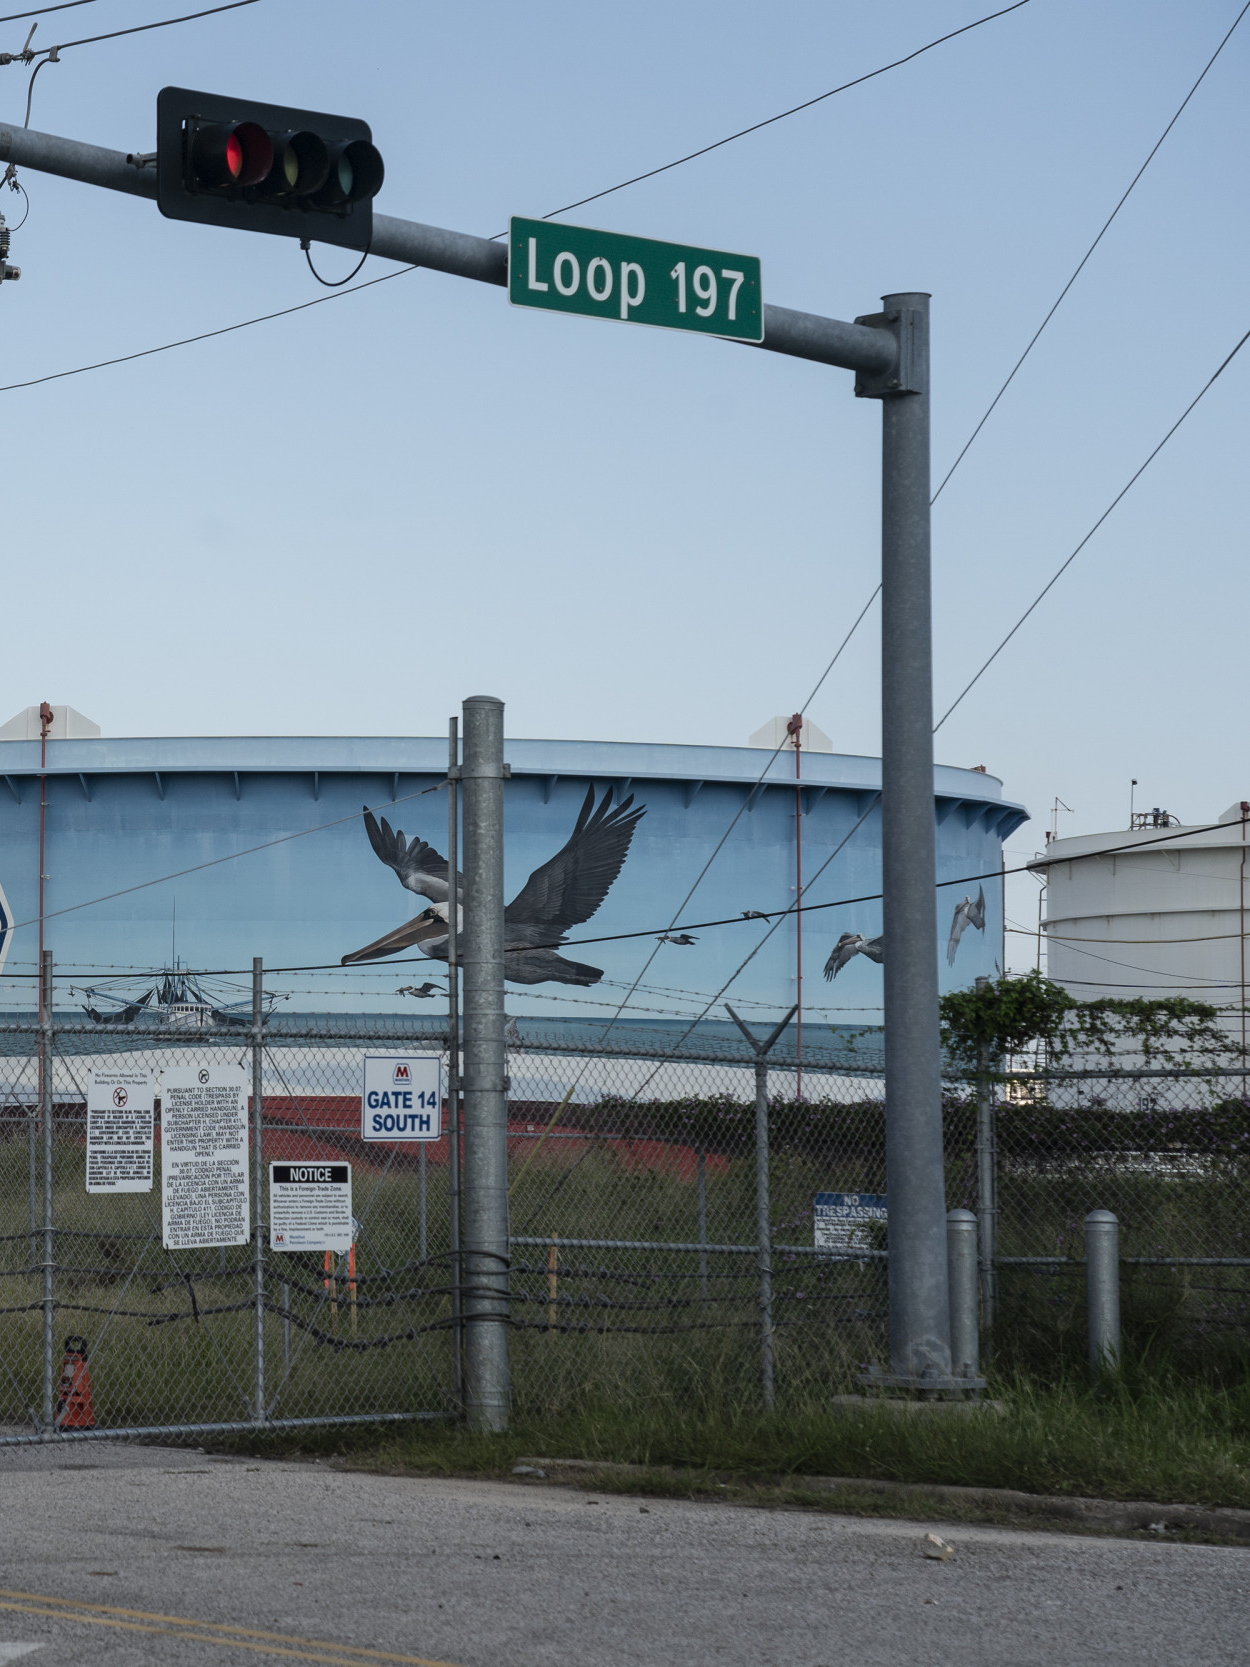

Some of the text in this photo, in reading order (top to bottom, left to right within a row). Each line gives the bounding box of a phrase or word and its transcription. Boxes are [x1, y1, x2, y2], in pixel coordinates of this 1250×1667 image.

[527, 237, 745, 321] Loop 197
[368, 1090, 437, 1109] GATE 14
[372, 1114, 430, 1132] SOUTH
[290, 1168, 332, 1181] NOTICE
[844, 1195, 859, 1206] NO
[816, 1206, 888, 1218] TRESPASSING
